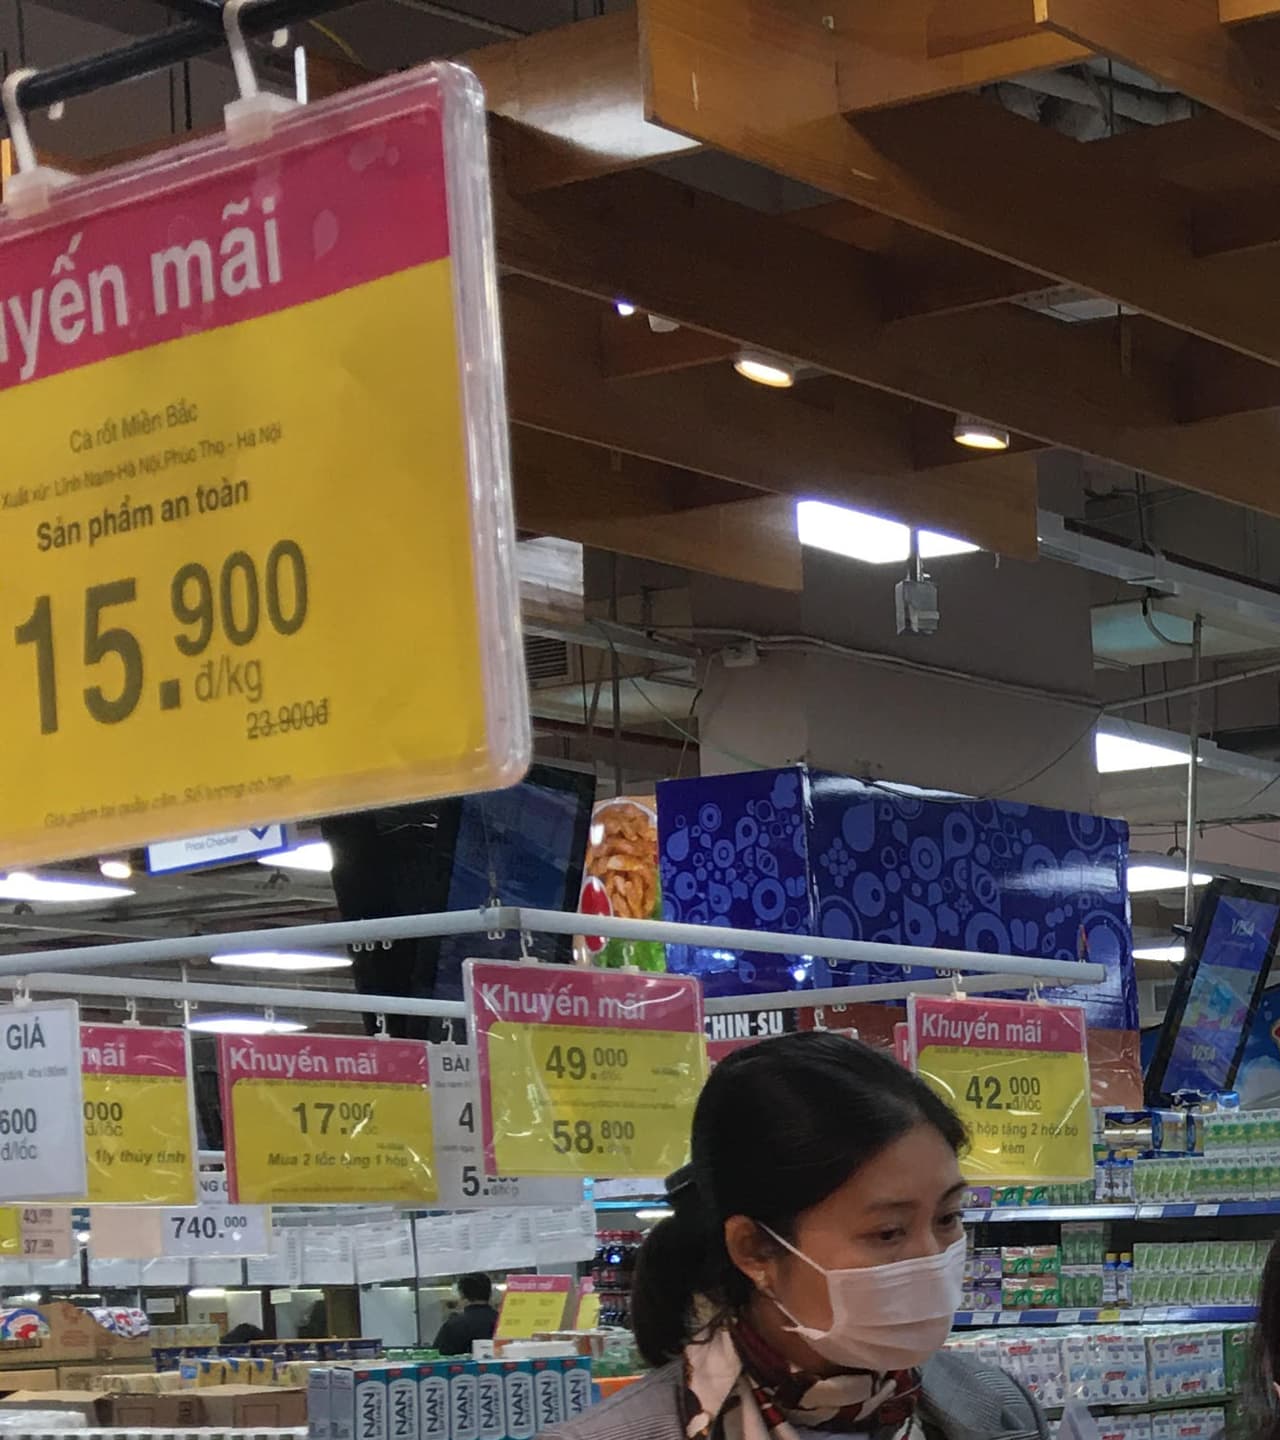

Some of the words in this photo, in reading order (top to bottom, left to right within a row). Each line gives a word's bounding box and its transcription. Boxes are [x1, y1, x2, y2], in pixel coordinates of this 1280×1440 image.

[152, 198, 283, 317] mãi
[36, 515, 81, 552] Sản
[88, 494, 154, 547] phẩm
[161, 495, 190, 523] an
[196, 476, 250, 515] toàn
[169, 538, 310, 658] 900
[194, 655, 264, 703] đ/kg
[247, 698, 329, 740] 23.900đ
[482, 983, 588, 1021] Khuyến
[599, 990, 645, 1020] mãi
[7, 1017, 45, 1050] GIÁ
[922, 1012, 999, 1045] Khuyến
[1006, 1019, 1042, 1042] mãi
[230, 1047, 334, 1077] Khuyến
[336, 1051, 377, 1075] mãi
[594, 1048, 628, 1066] 000
[1009, 1077, 1041, 1095] 000
[340, 1102, 373, 1121] 000
[224, 1216, 247, 1228] 000
[363, 1391, 375, 1438] NAN
[395, 1389, 407, 1435] NAN
[427, 1387, 438, 1432] NAN
[457, 1385, 469, 1430] NAN
[482, 1384, 494, 1429] NAN
